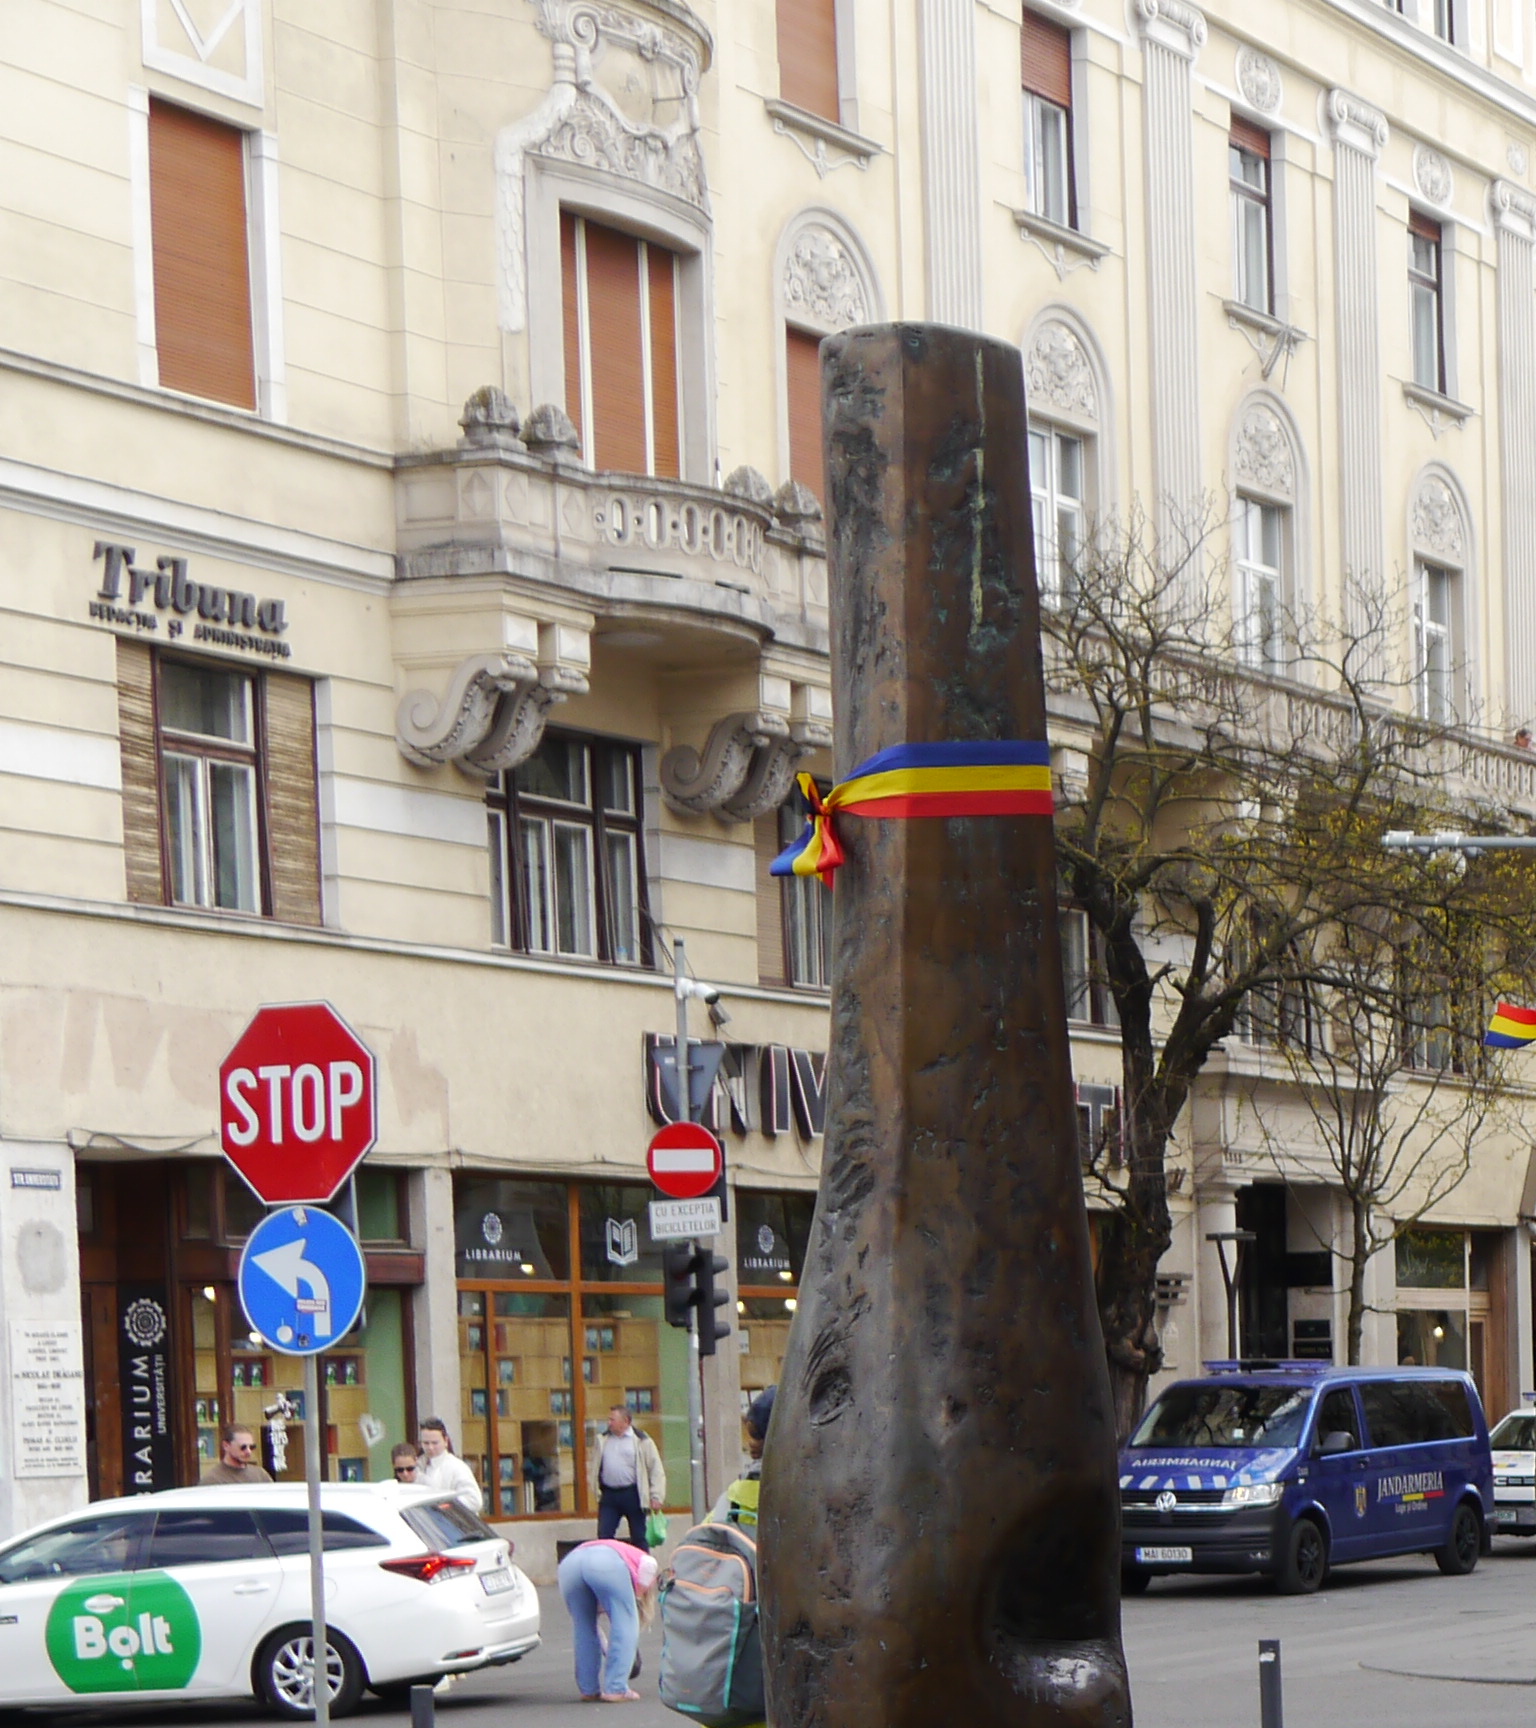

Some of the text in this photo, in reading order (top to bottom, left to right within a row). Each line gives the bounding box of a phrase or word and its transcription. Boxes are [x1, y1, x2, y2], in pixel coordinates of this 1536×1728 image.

[93, 541, 288, 633] Tribuna
[227, 1060, 364, 1146] STOP
[655, 1202, 715, 1217] CU EXCEPȚIA
[655, 1219, 717, 1234] BICICLETELOR
[465, 1248, 522, 1261] LIBRARIUM
[744, 1257, 791, 1269] LIBRARIUM
[1377, 1471, 1444, 1503] JANDARMERIA
[1143, 1549, 1188, 1559] MAI 60130
[73, 1612, 174, 1671] Bolt
